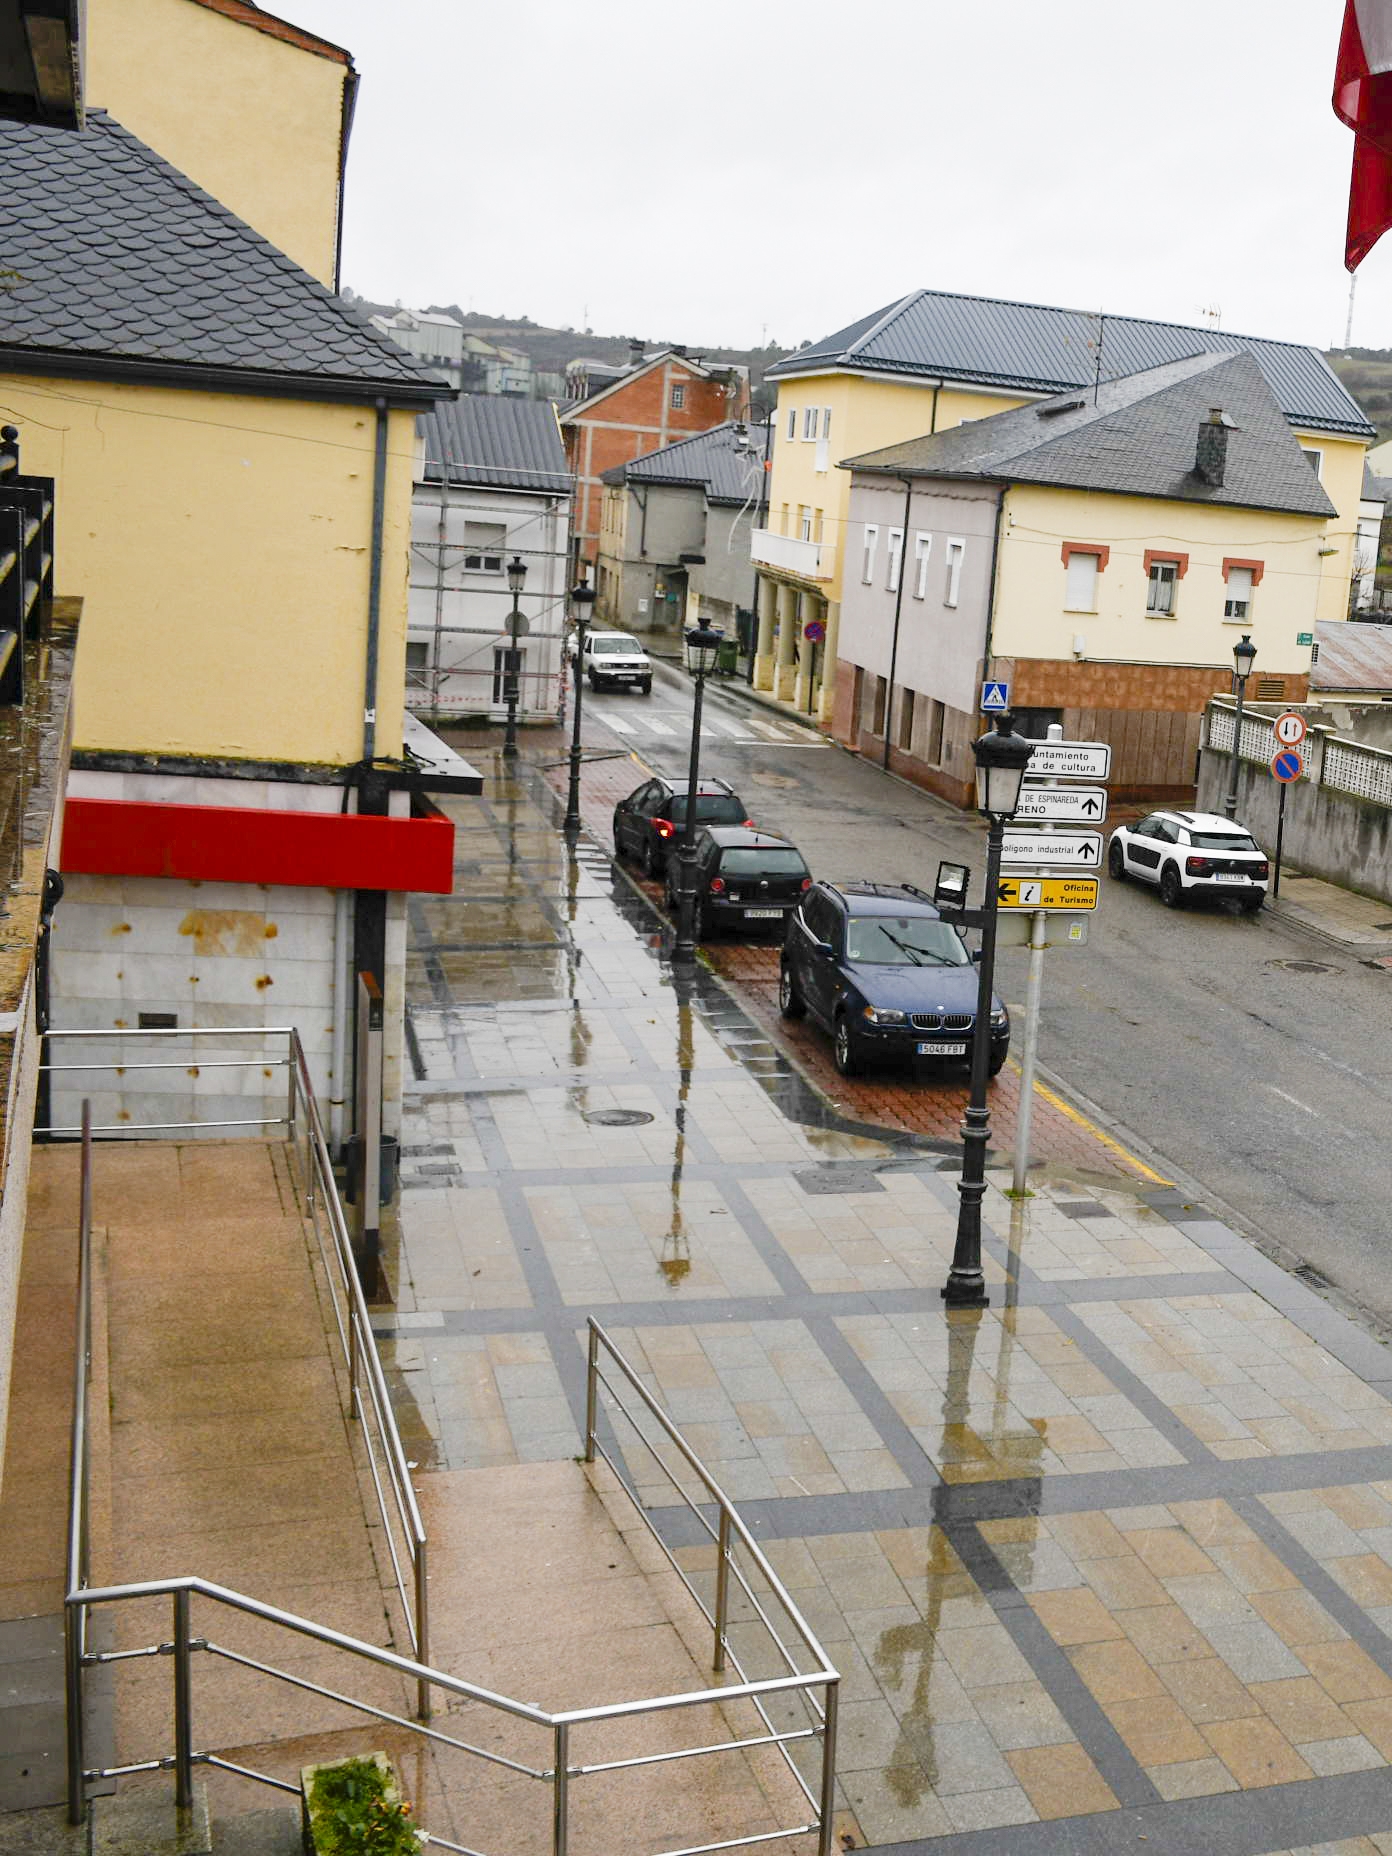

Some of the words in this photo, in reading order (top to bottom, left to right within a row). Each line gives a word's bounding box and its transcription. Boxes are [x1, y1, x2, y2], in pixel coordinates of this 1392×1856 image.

[1042, 762, 1055, 770] de
[1061, 763, 1096, 772] cultura
[1025, 794, 1034, 803] DE
[1037, 844, 1074, 854] industrial
[1063, 884, 1094, 892] Oficina
[1060, 896, 1094, 904] Turismo
